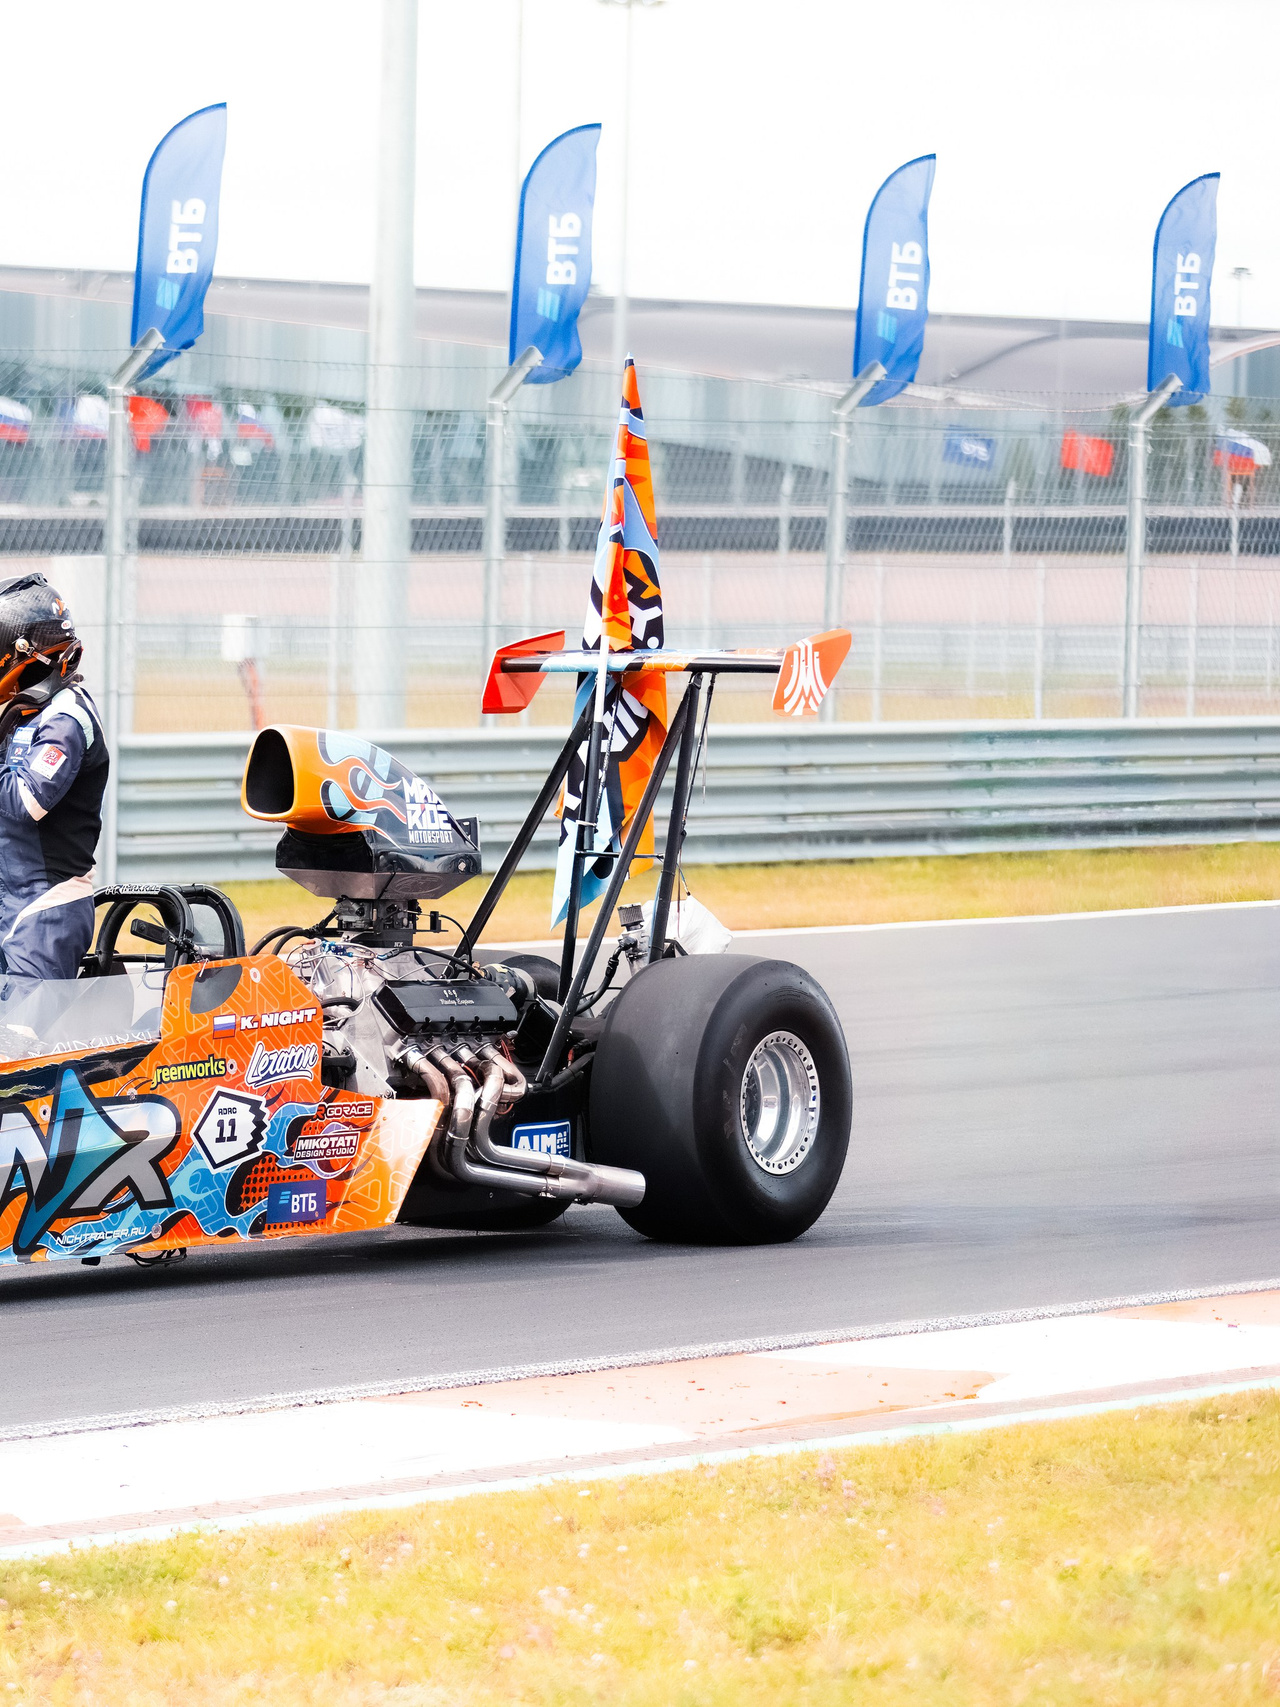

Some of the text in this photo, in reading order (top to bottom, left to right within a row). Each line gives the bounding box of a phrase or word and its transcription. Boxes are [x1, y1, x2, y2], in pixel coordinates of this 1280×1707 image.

[166, 198, 207, 273] ВТБ
[546, 212, 582, 285] ВТБ
[886, 241, 923, 311] ВТБ
[1174, 252, 1201, 316] ВТБ
[408, 830, 453, 844] MOTORSPORT
[240, 1008, 317, 1030] K. NIGHT
[218, 1107, 238, 1115] RDRC
[215, 1118, 238, 1143] 11
[296, 1147, 355, 1158] DESIGN STUDIO
[298, 1136, 358, 1150] MIKOTATI
[291, 1192, 317, 1213] ВТБ
[55, 1226, 148, 1245] NIGHTRACER.RU
